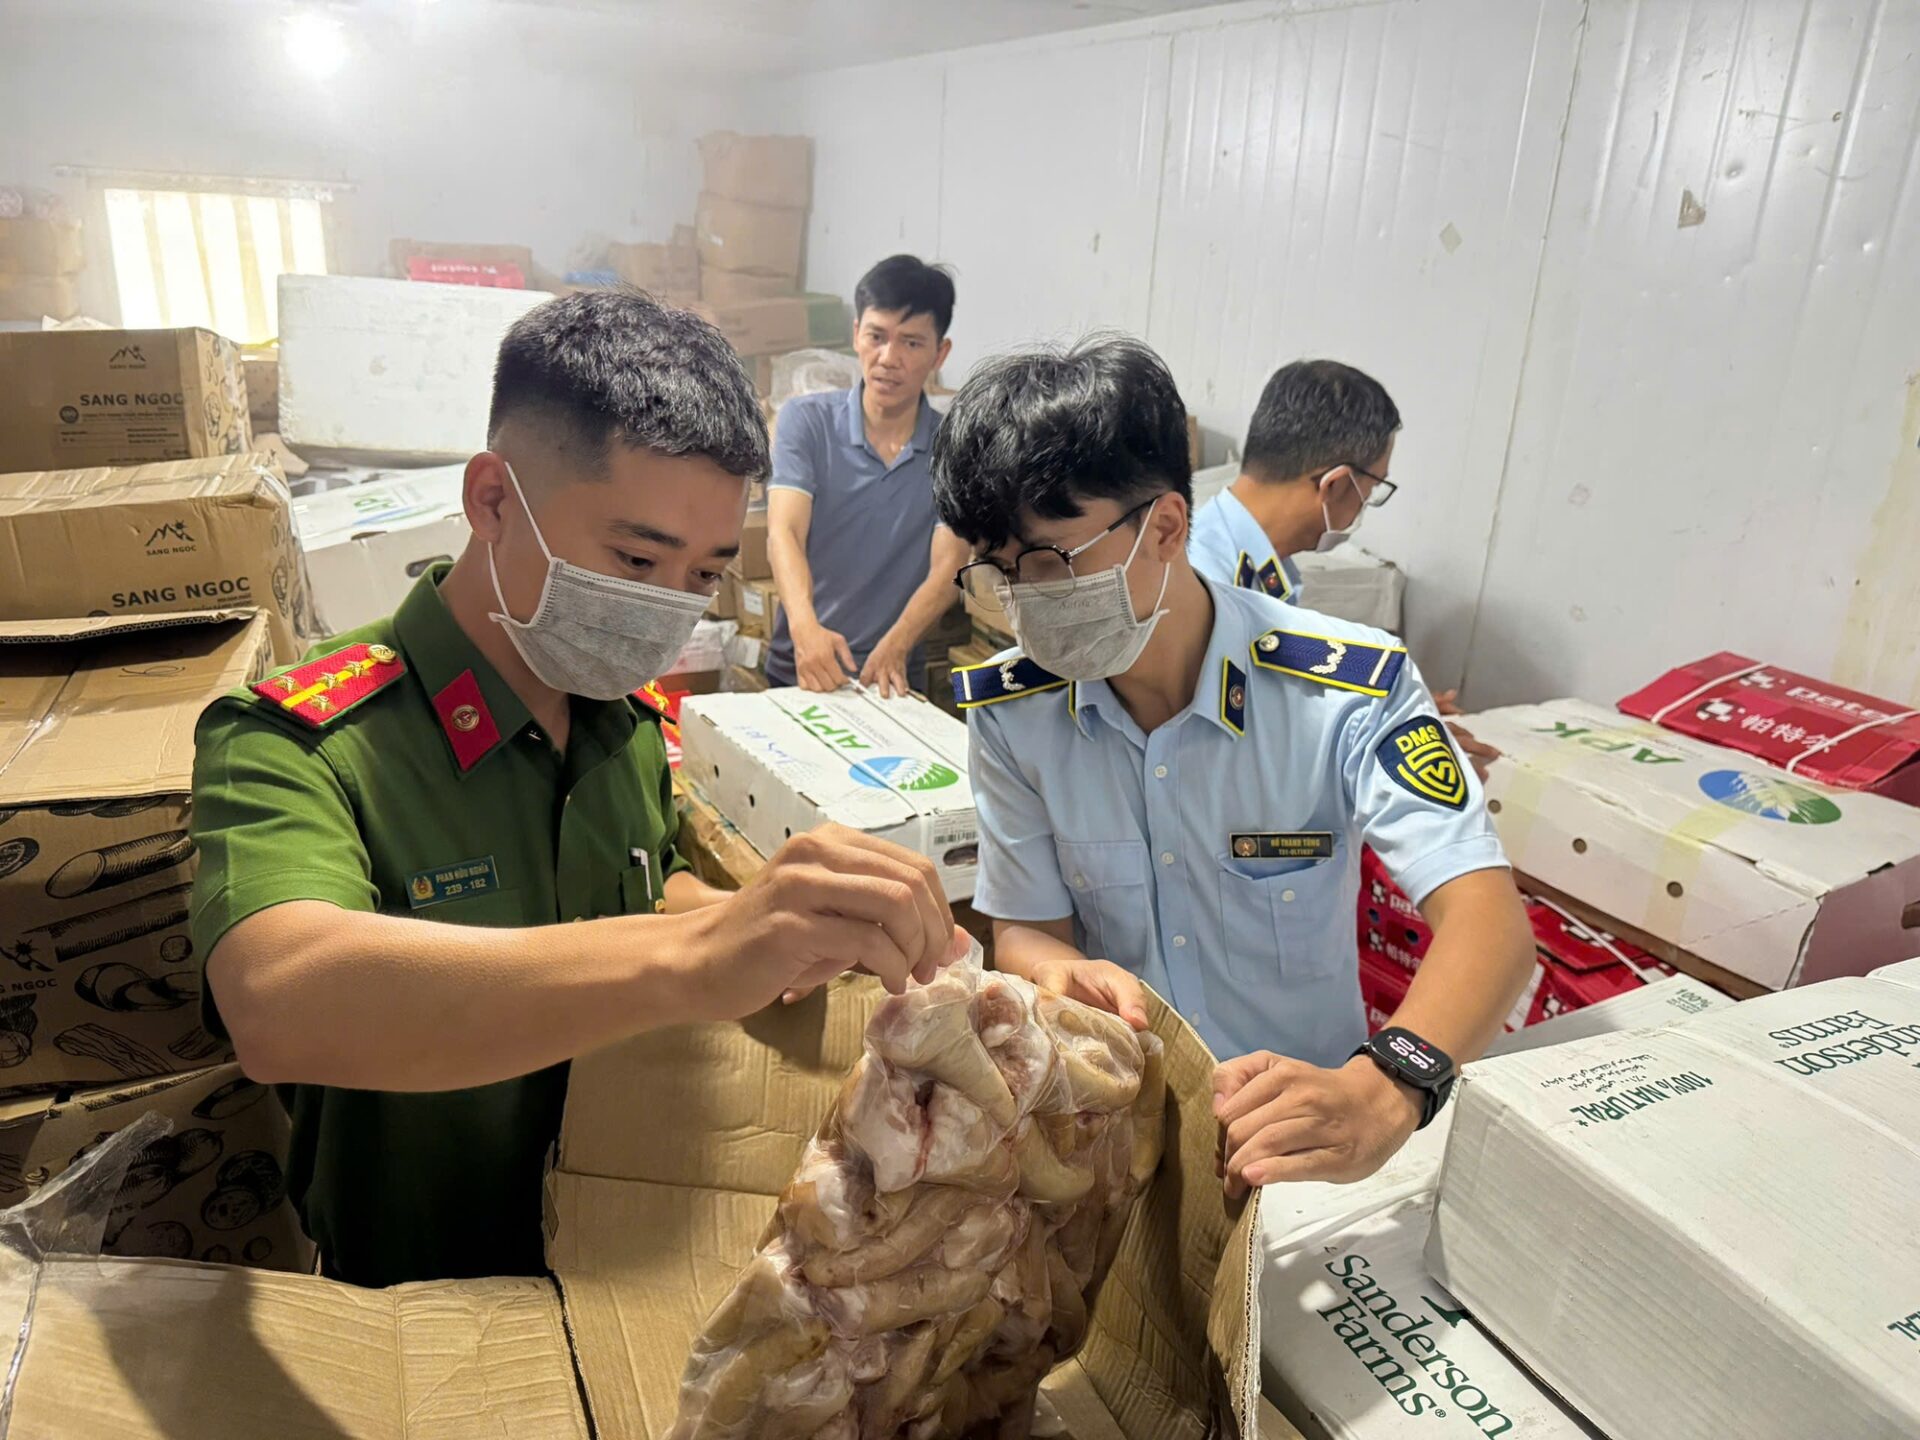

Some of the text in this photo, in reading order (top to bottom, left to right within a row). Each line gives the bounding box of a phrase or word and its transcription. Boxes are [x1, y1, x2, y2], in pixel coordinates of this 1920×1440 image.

[80, 392, 184, 406] SANG NGOC
[146, 545, 197, 556] SANG NGOC
[111, 587, 176, 608] SANG
[185, 577, 250, 599] NGOC
[1395, 725, 1441, 753] DMS
[12, 978, 58, 991] NGOC
[1389, 1036, 1416, 1057] 09
[1774, 1024, 1920, 1075] nderson
[1409, 1050, 1436, 1070] 16
[1655, 1071, 1713, 1096] 100%
[1325, 1254, 1513, 1440] Sanderson
